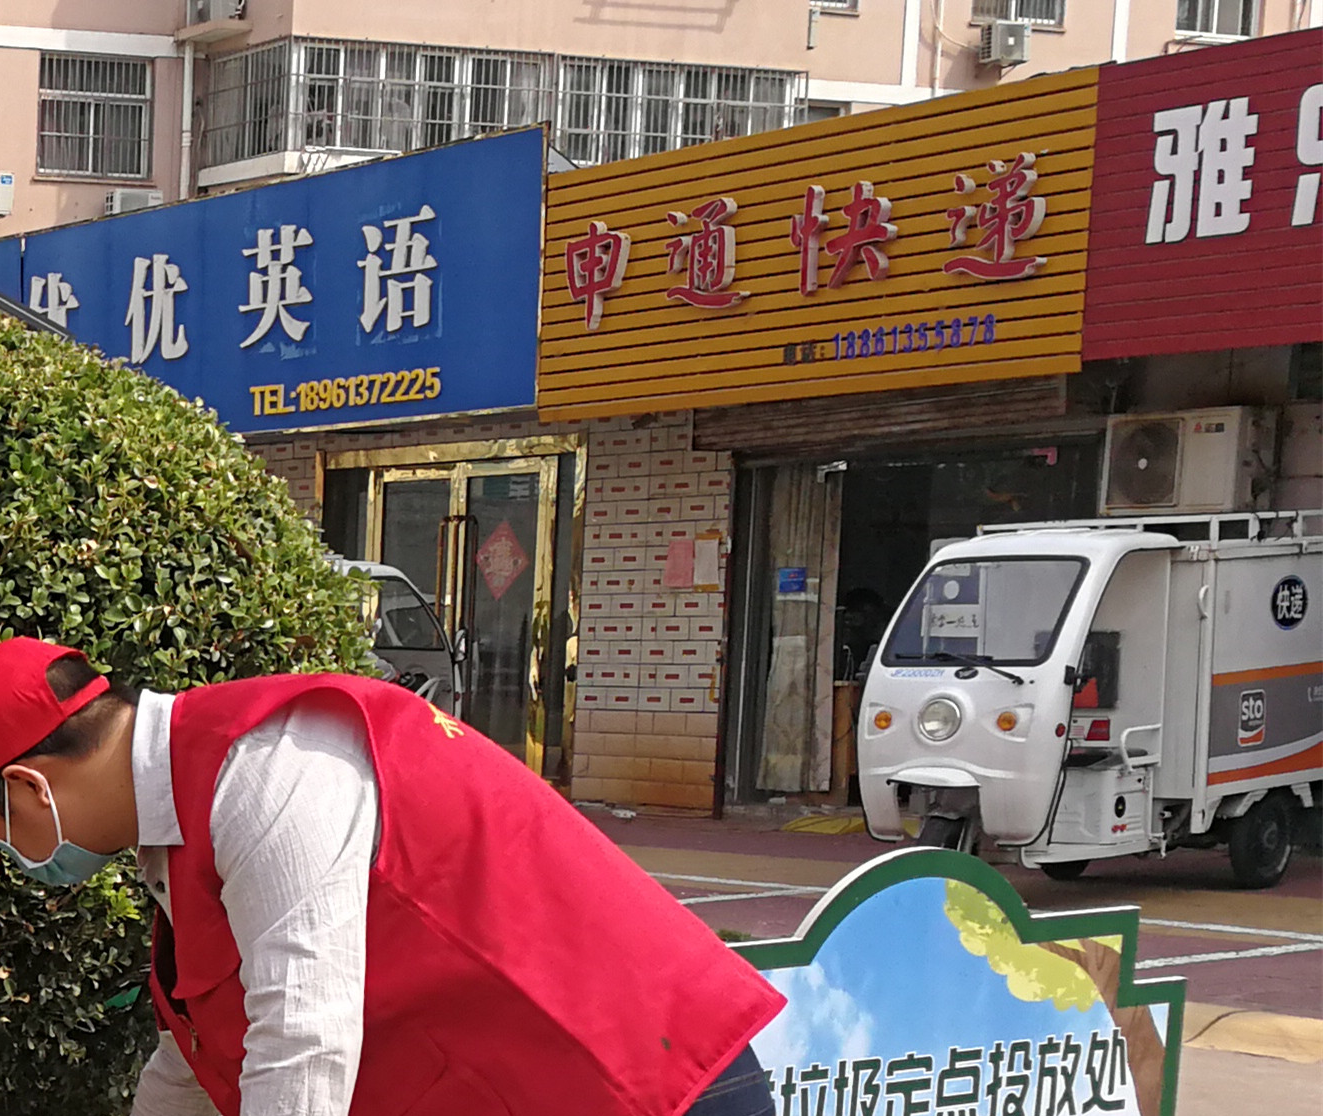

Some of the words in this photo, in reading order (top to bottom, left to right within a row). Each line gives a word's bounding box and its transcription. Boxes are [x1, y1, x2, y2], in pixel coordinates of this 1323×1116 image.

[564, 150, 1049, 331] 申通快递
[249, 366, 442, 416] TEL:18961372225
[1276, 584, 1304, 620] 快递
